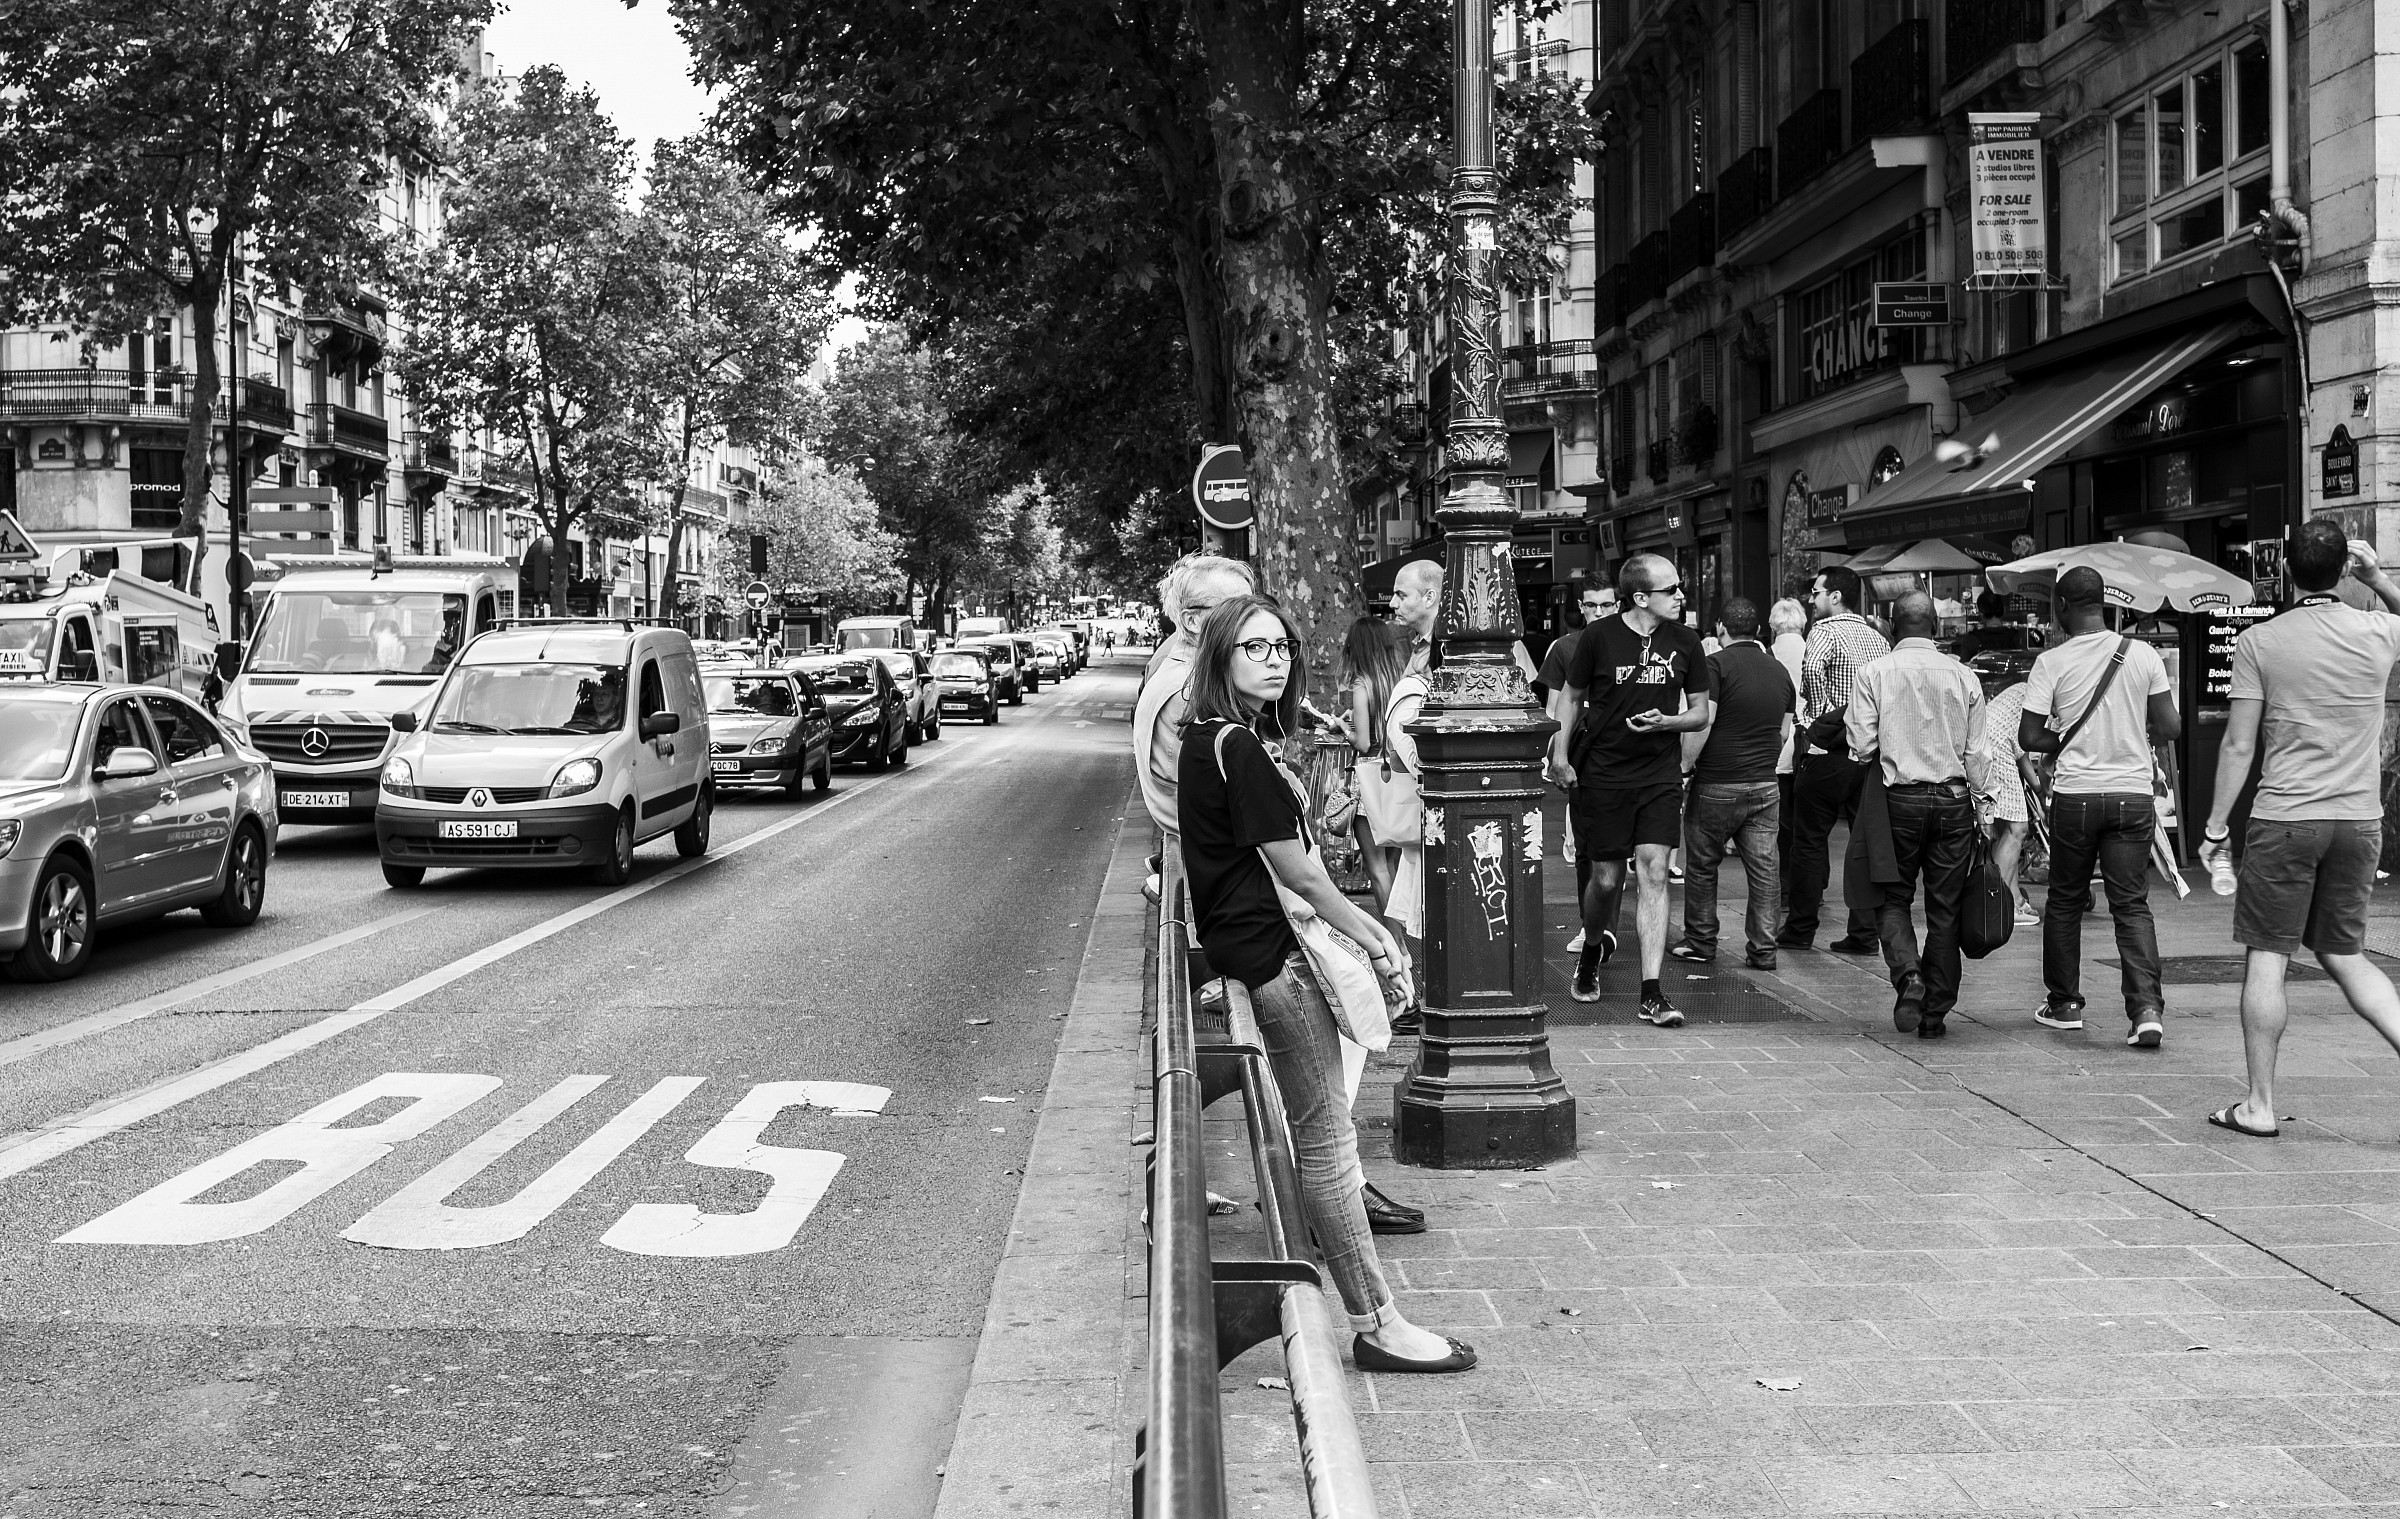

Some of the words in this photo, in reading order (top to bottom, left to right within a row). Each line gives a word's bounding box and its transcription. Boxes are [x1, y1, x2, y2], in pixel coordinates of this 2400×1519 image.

[1976, 150, 1985, 161] A
[1987, 149, 2034, 161] VENDRE
[1984, 164, 2011, 172] studios
[2013, 163, 2036, 172] libres
[1976, 174, 1982, 182] 3
[1984, 173, 2007, 184] pièces
[2009, 172, 2036, 183] occupé
[1979, 195, 2003, 206] FOR
[2004, 194, 2032, 206] SALE
[1986, 209, 1992, 217] 2
[1992, 209, 2029, 217] one-room
[1977, 217, 2010, 227] occupied
[2011, 217, 2039, 225] 3-room
[1976, 251, 1982, 261] 0
[1984, 251, 2003, 261] 810
[2005, 250, 2023, 260] 508
[2025, 250, 2043, 260] 508
[1893, 308, 1932, 320] Change
[1813, 312, 1888, 383] CHANGE
[130, 483, 181, 492] promod
[1811, 493, 1844, 522] Change
[2303, 597, 2333, 605] Canon
[2242, 604, 2275, 615] demande
[2226, 616, 2254, 626] Crêpes
[2209, 625, 2237, 635] Gaufre
[52, 1072, 893, 1258] BUS
